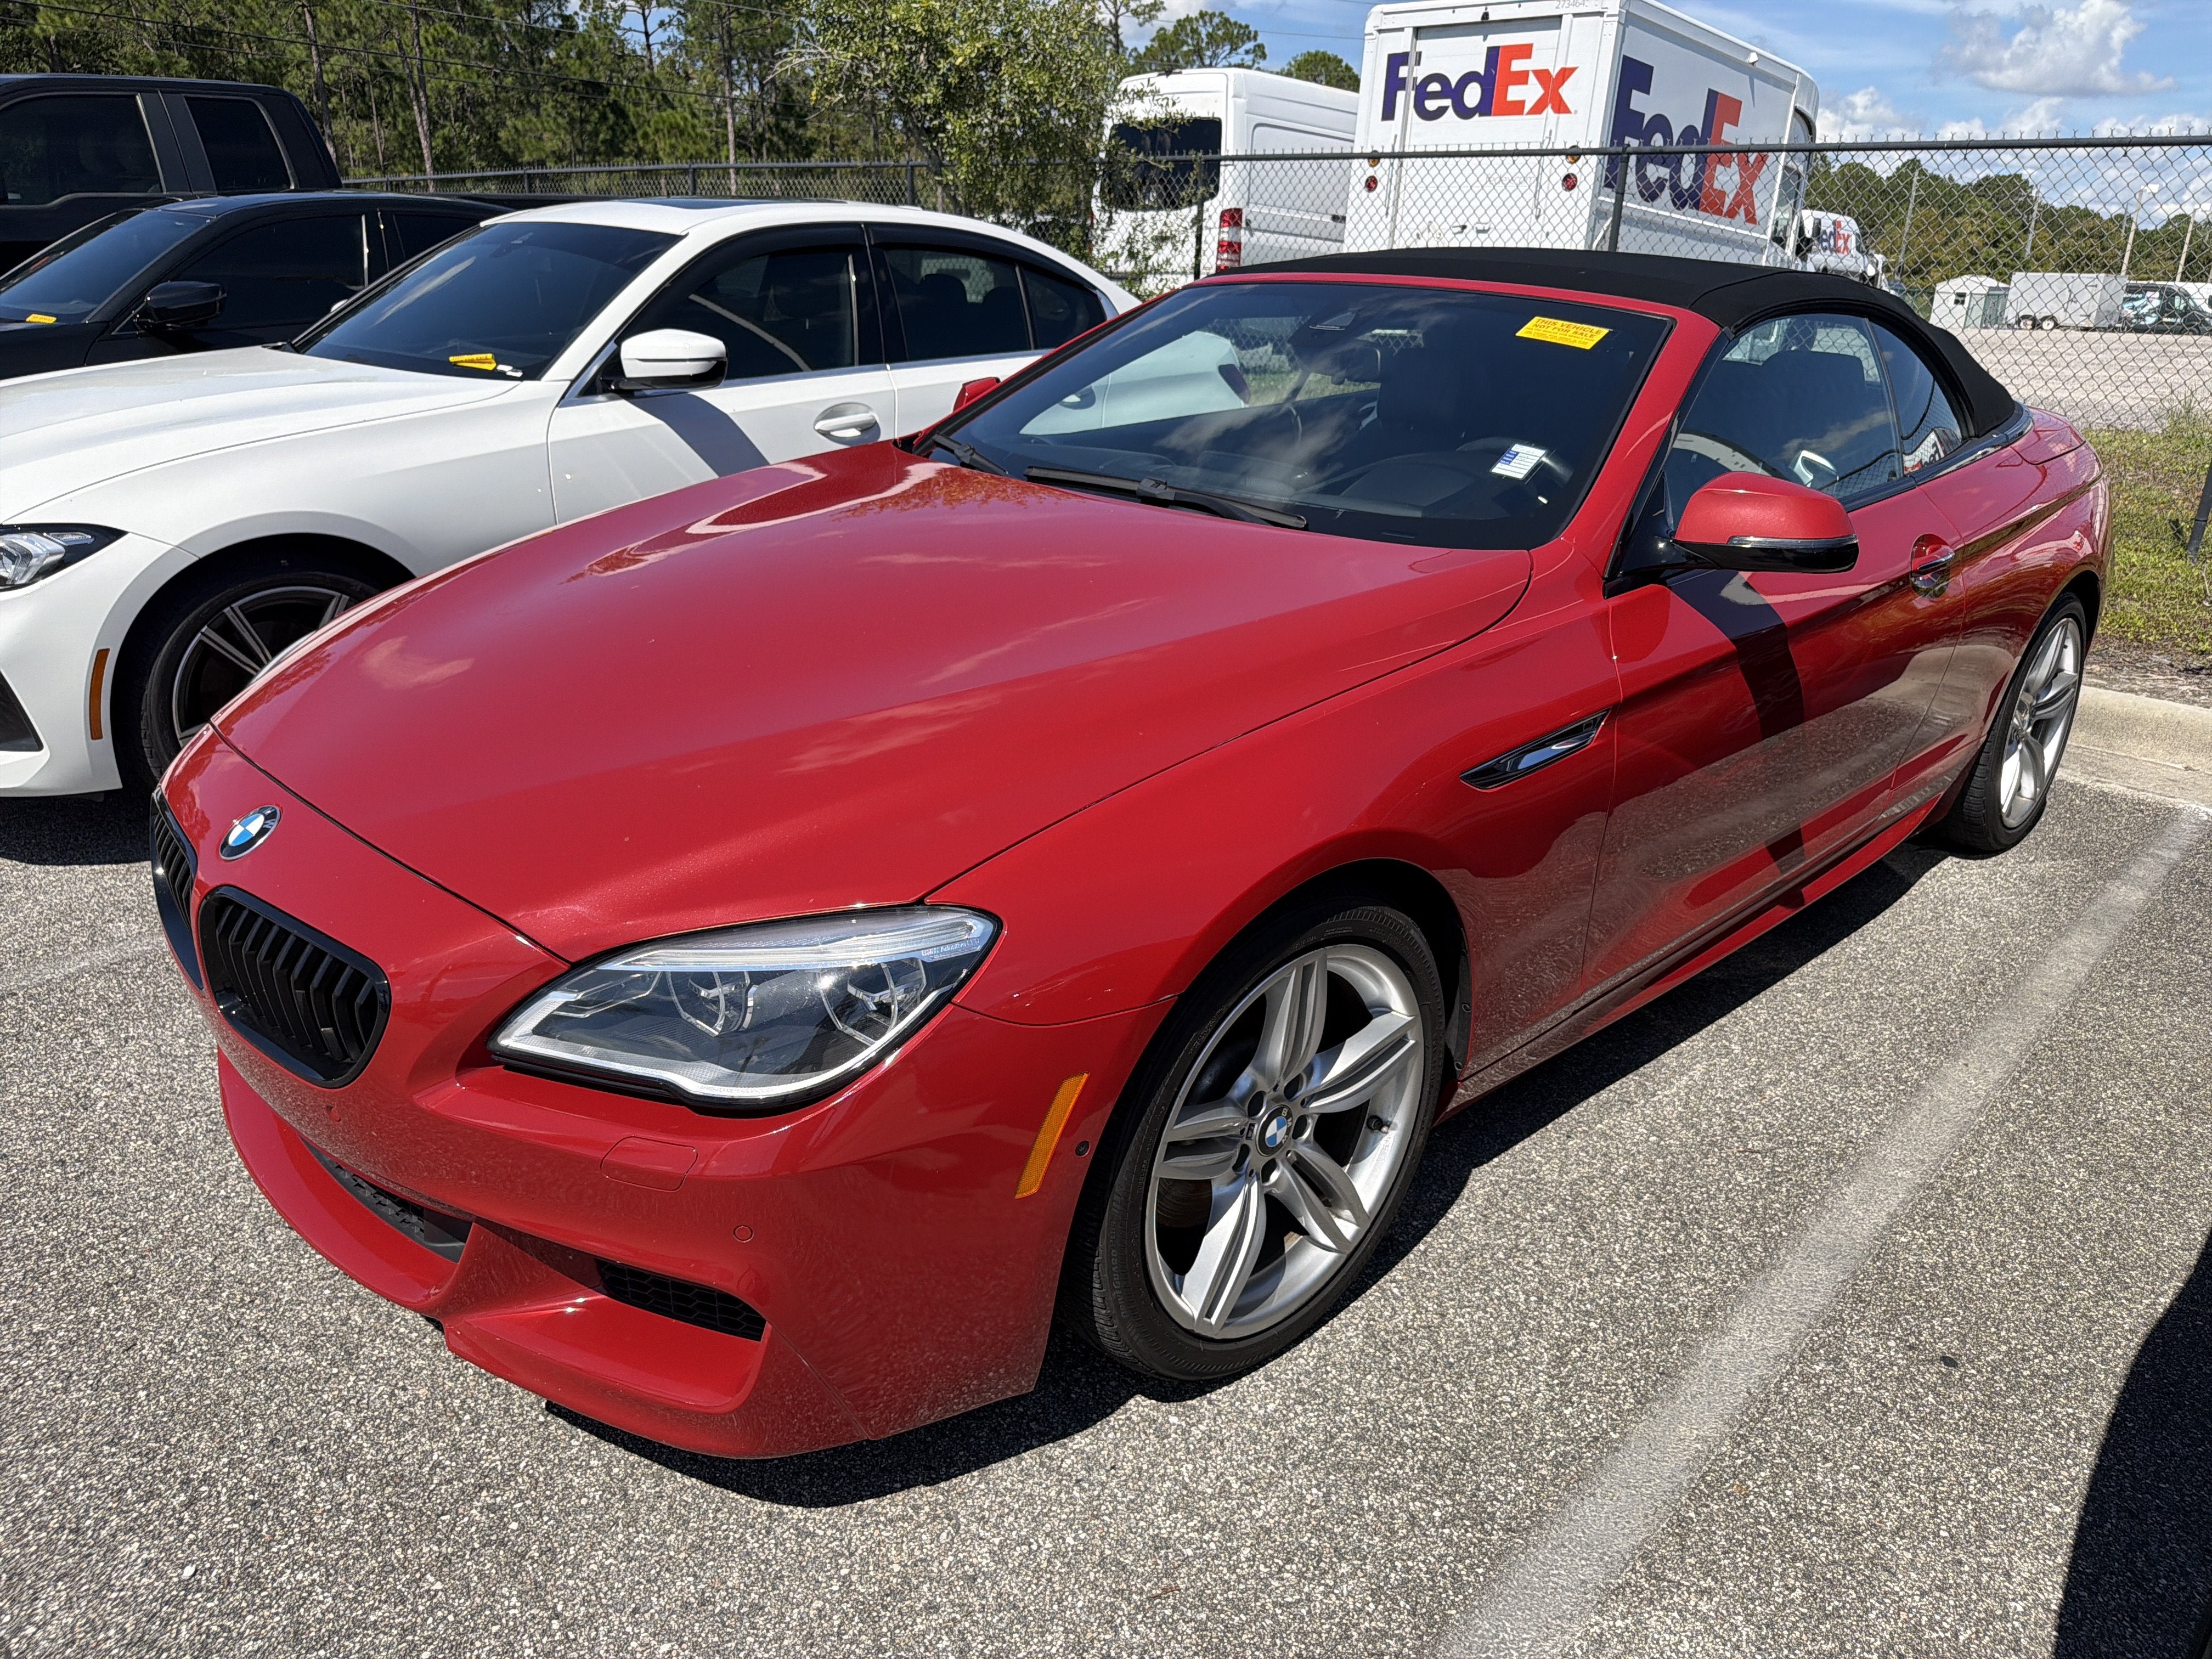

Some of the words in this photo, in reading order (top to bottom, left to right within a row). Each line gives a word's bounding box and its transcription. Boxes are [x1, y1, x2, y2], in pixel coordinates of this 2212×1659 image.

[1381, 43, 1578, 122] FedEx
[1604, 54, 1769, 225] FedEx
[1560, 323, 1602, 335] VEHICLE
[1281, 1108, 1292, 1145] BMW
